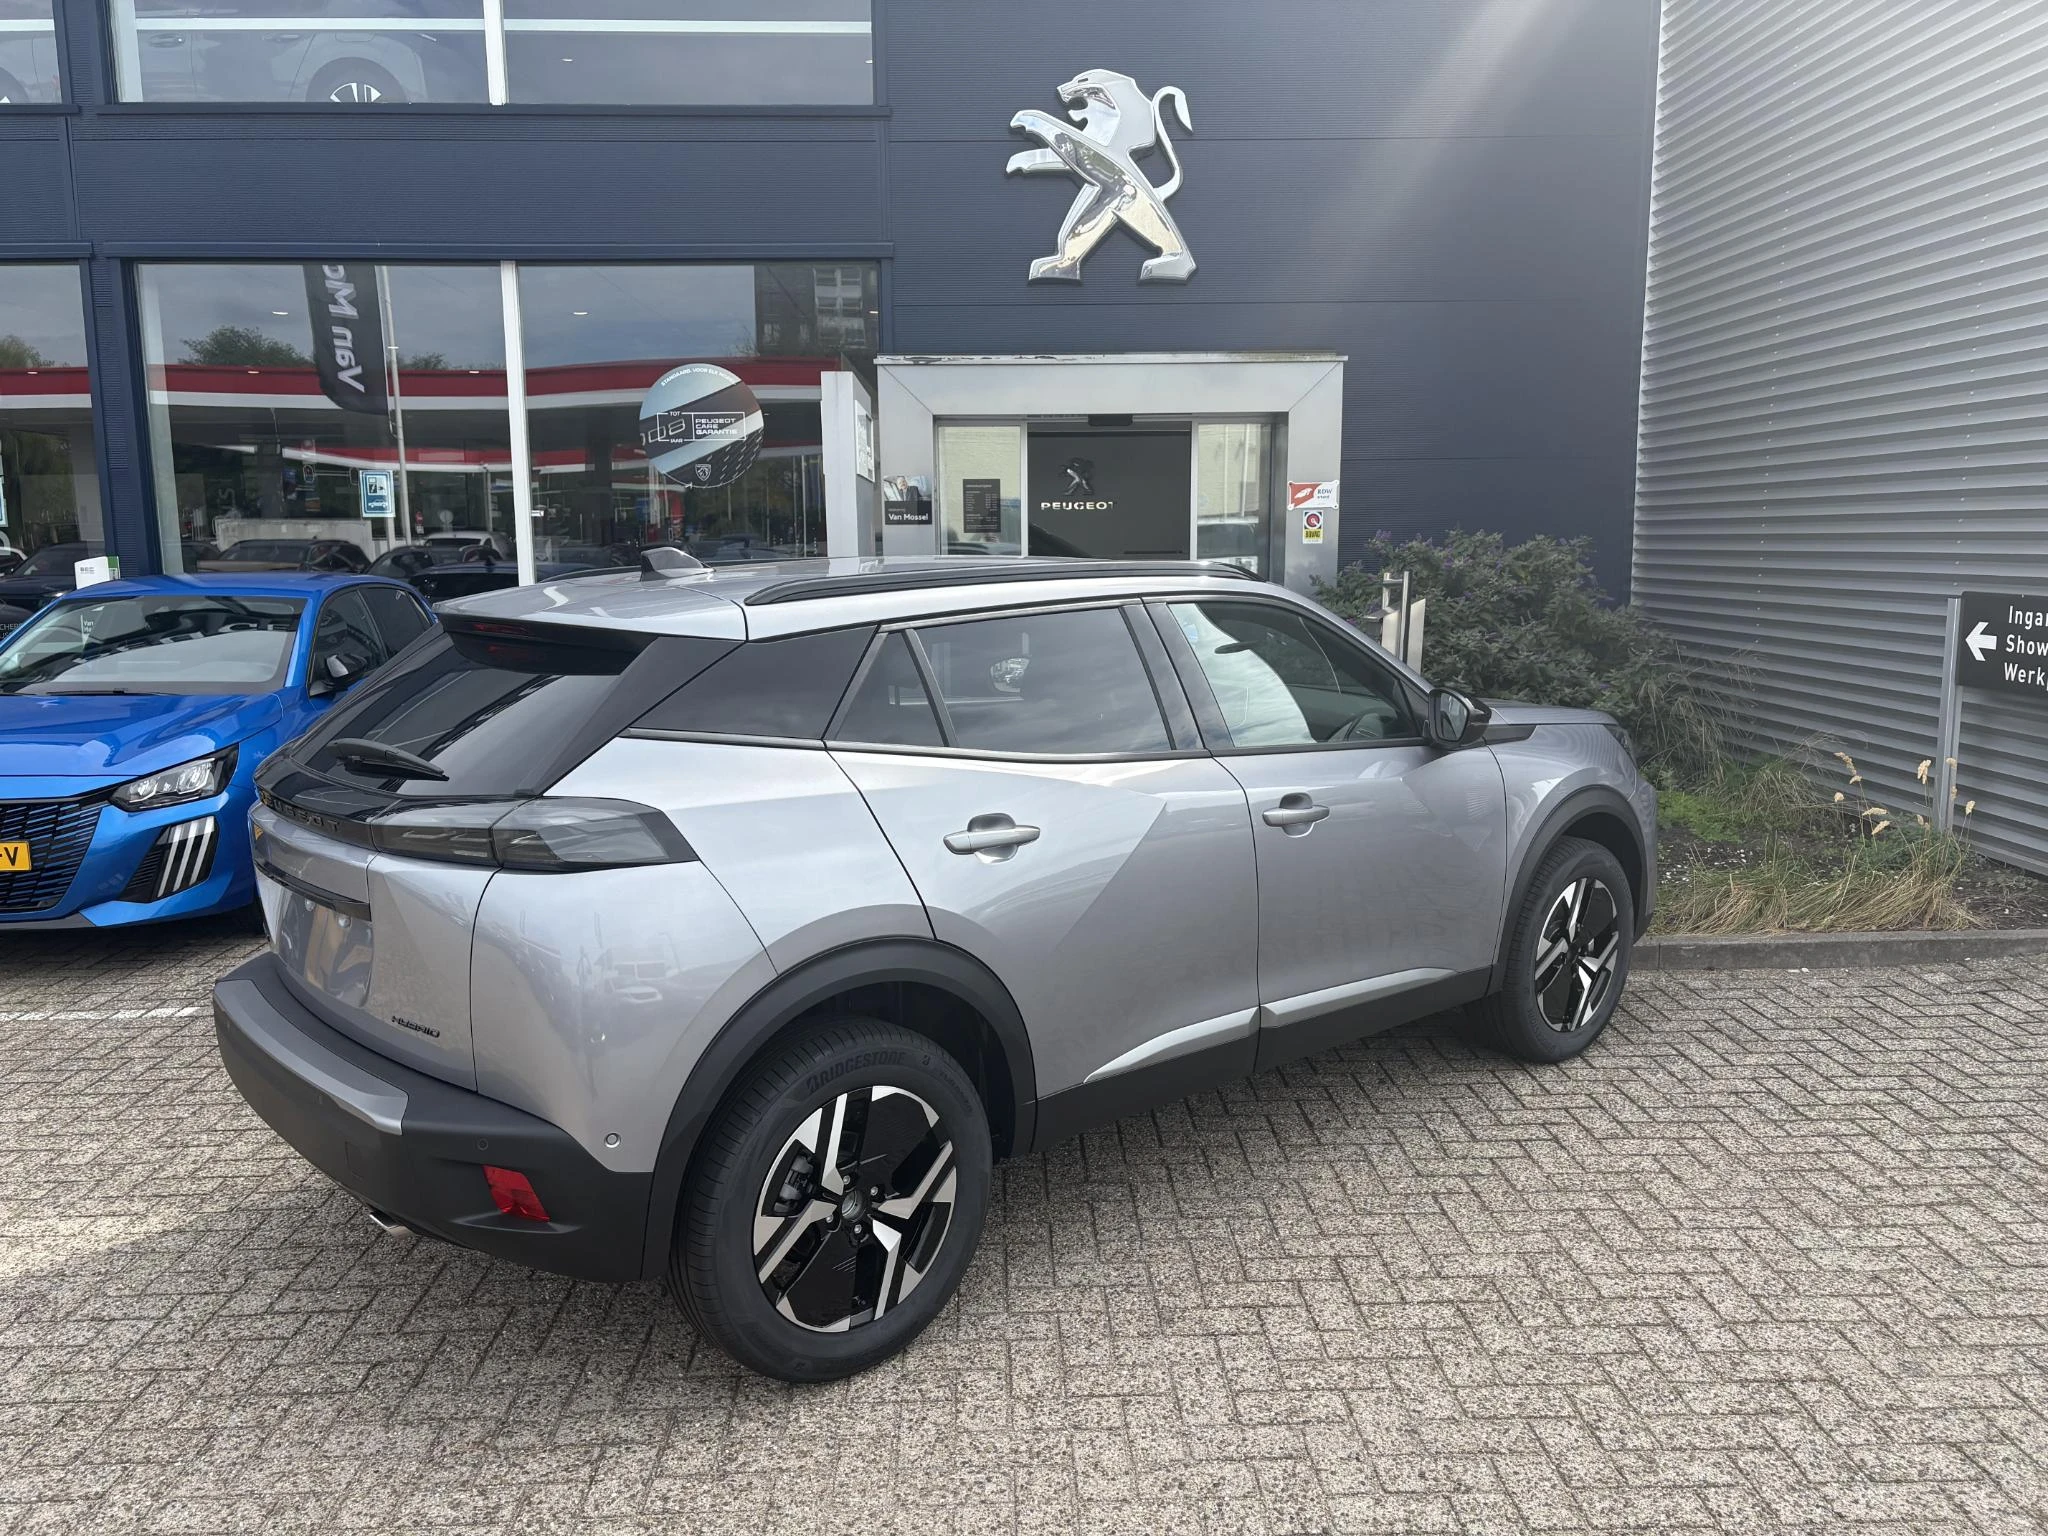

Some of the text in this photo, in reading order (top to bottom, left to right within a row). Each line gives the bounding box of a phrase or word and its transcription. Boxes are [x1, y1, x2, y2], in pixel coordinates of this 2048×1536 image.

[888, 513, 929, 521] Van Mossel
[1040, 501, 1114, 511] PEUGEOT
[2008, 605, 2048, 630] Inga
[2006, 634, 2048, 656] Show
[2004, 662, 2048, 692] Werk
[391, 1015, 440, 1038] HYBRID
[805, 1051, 906, 1096] BRIDGESTONE
